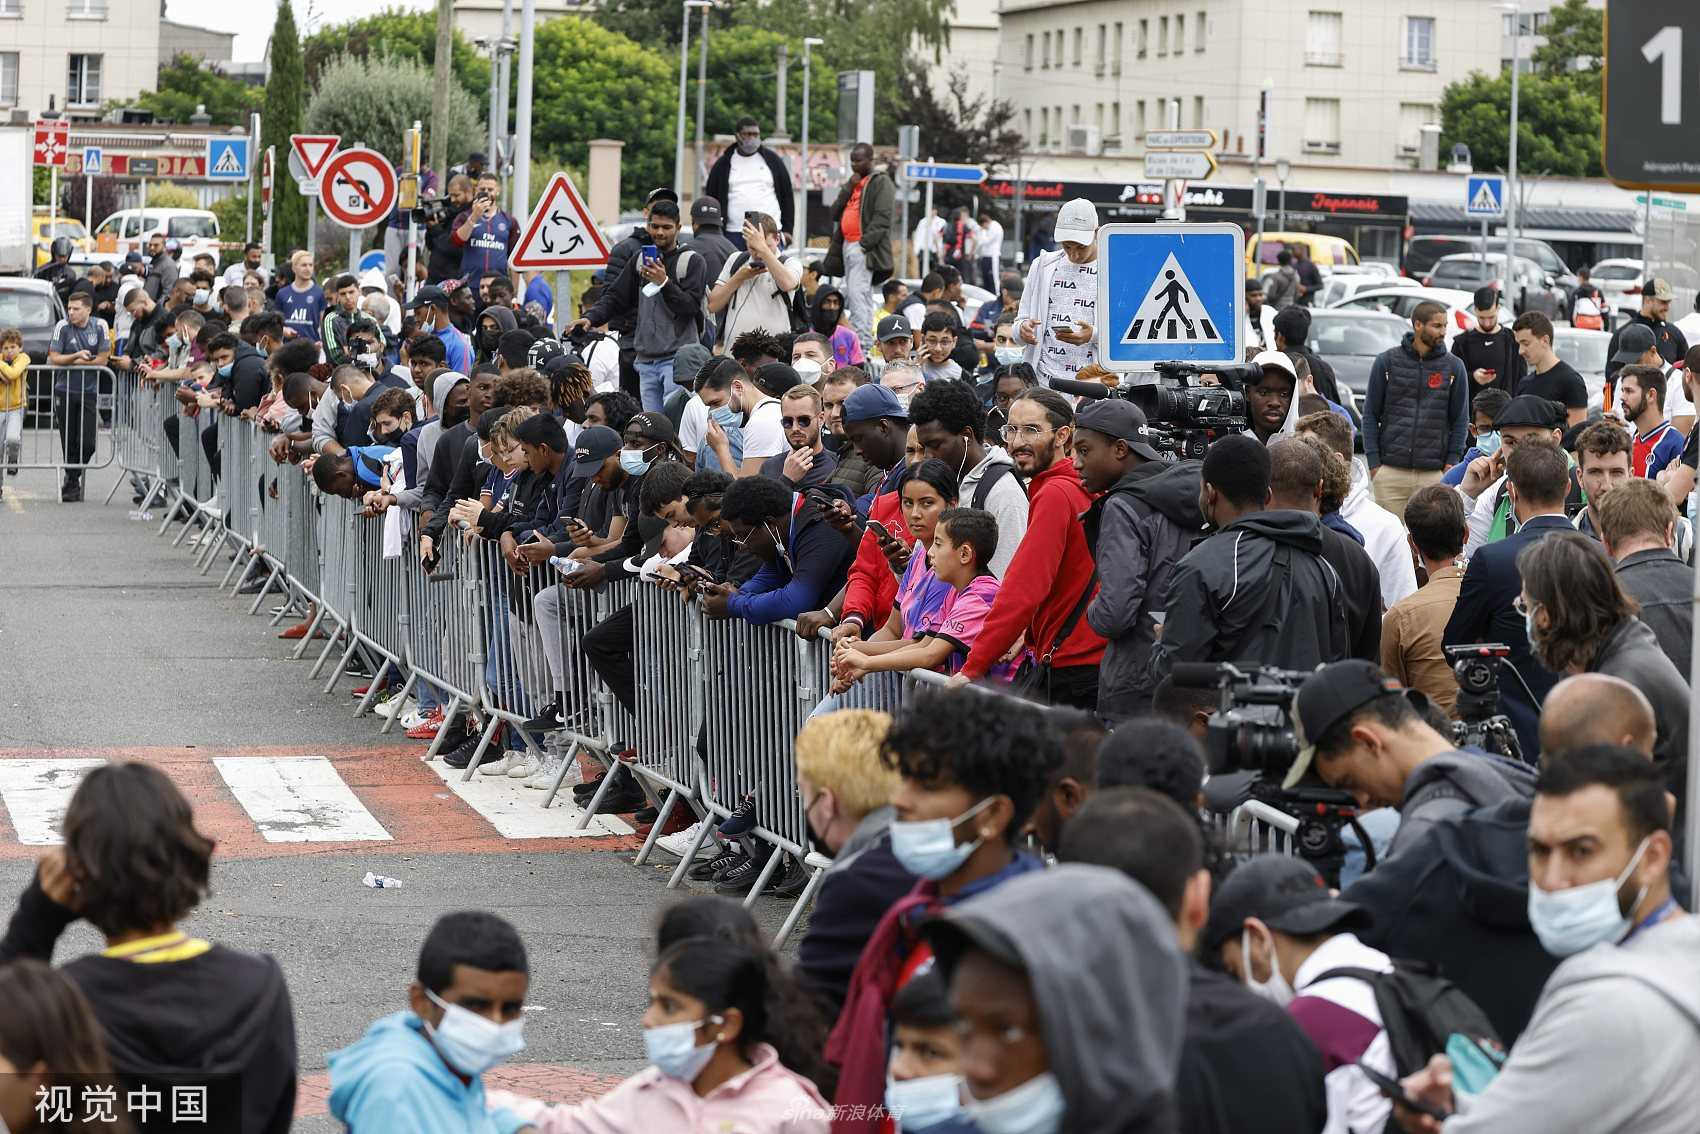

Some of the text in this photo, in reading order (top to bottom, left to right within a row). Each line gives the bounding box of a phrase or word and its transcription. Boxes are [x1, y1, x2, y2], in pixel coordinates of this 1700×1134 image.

[1641, 26, 1682, 124] 1
[1079, 266, 1098, 275] FIL
[1053, 280, 1077, 289] FILA
[1073, 298, 1095, 308] FILA
[1051, 313, 1072, 322] FILA
[1047, 346, 1066, 355] FILA
[1064, 364, 1084, 373] FIL
